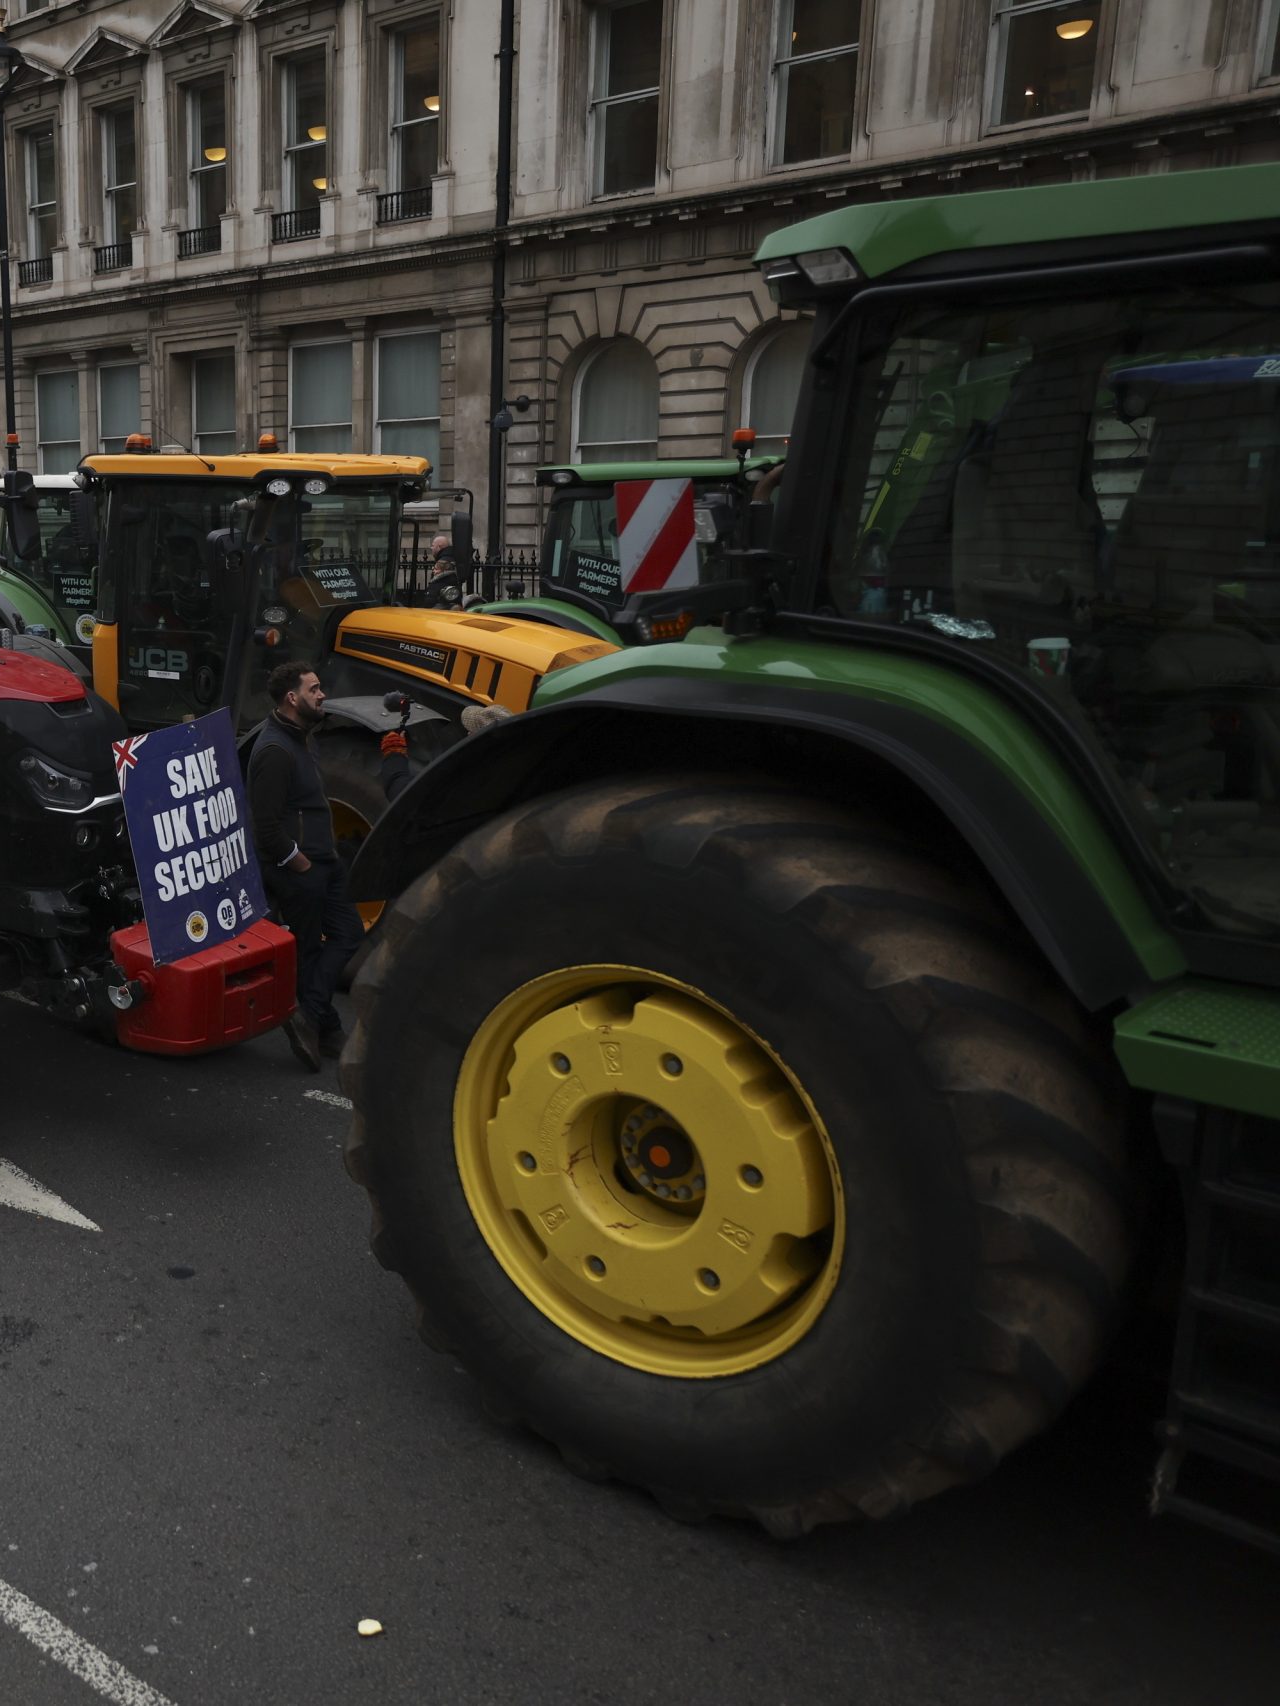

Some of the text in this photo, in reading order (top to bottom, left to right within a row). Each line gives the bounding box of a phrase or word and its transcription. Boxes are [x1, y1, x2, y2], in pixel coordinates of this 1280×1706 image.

[313, 567, 351, 578] WITH OUR
[577, 556, 621, 575] WITH OUR
[60, 577, 78, 587] WITH
[321, 578, 357, 590] FARMERS
[576, 568, 618, 587] FARMERS
[579, 582, 610, 595] #together
[128, 647, 189, 673] JCB
[166, 746, 221, 799] SAVE
[152, 787, 238, 853] UK FOOD
[154, 827, 248, 902] SECURITY
